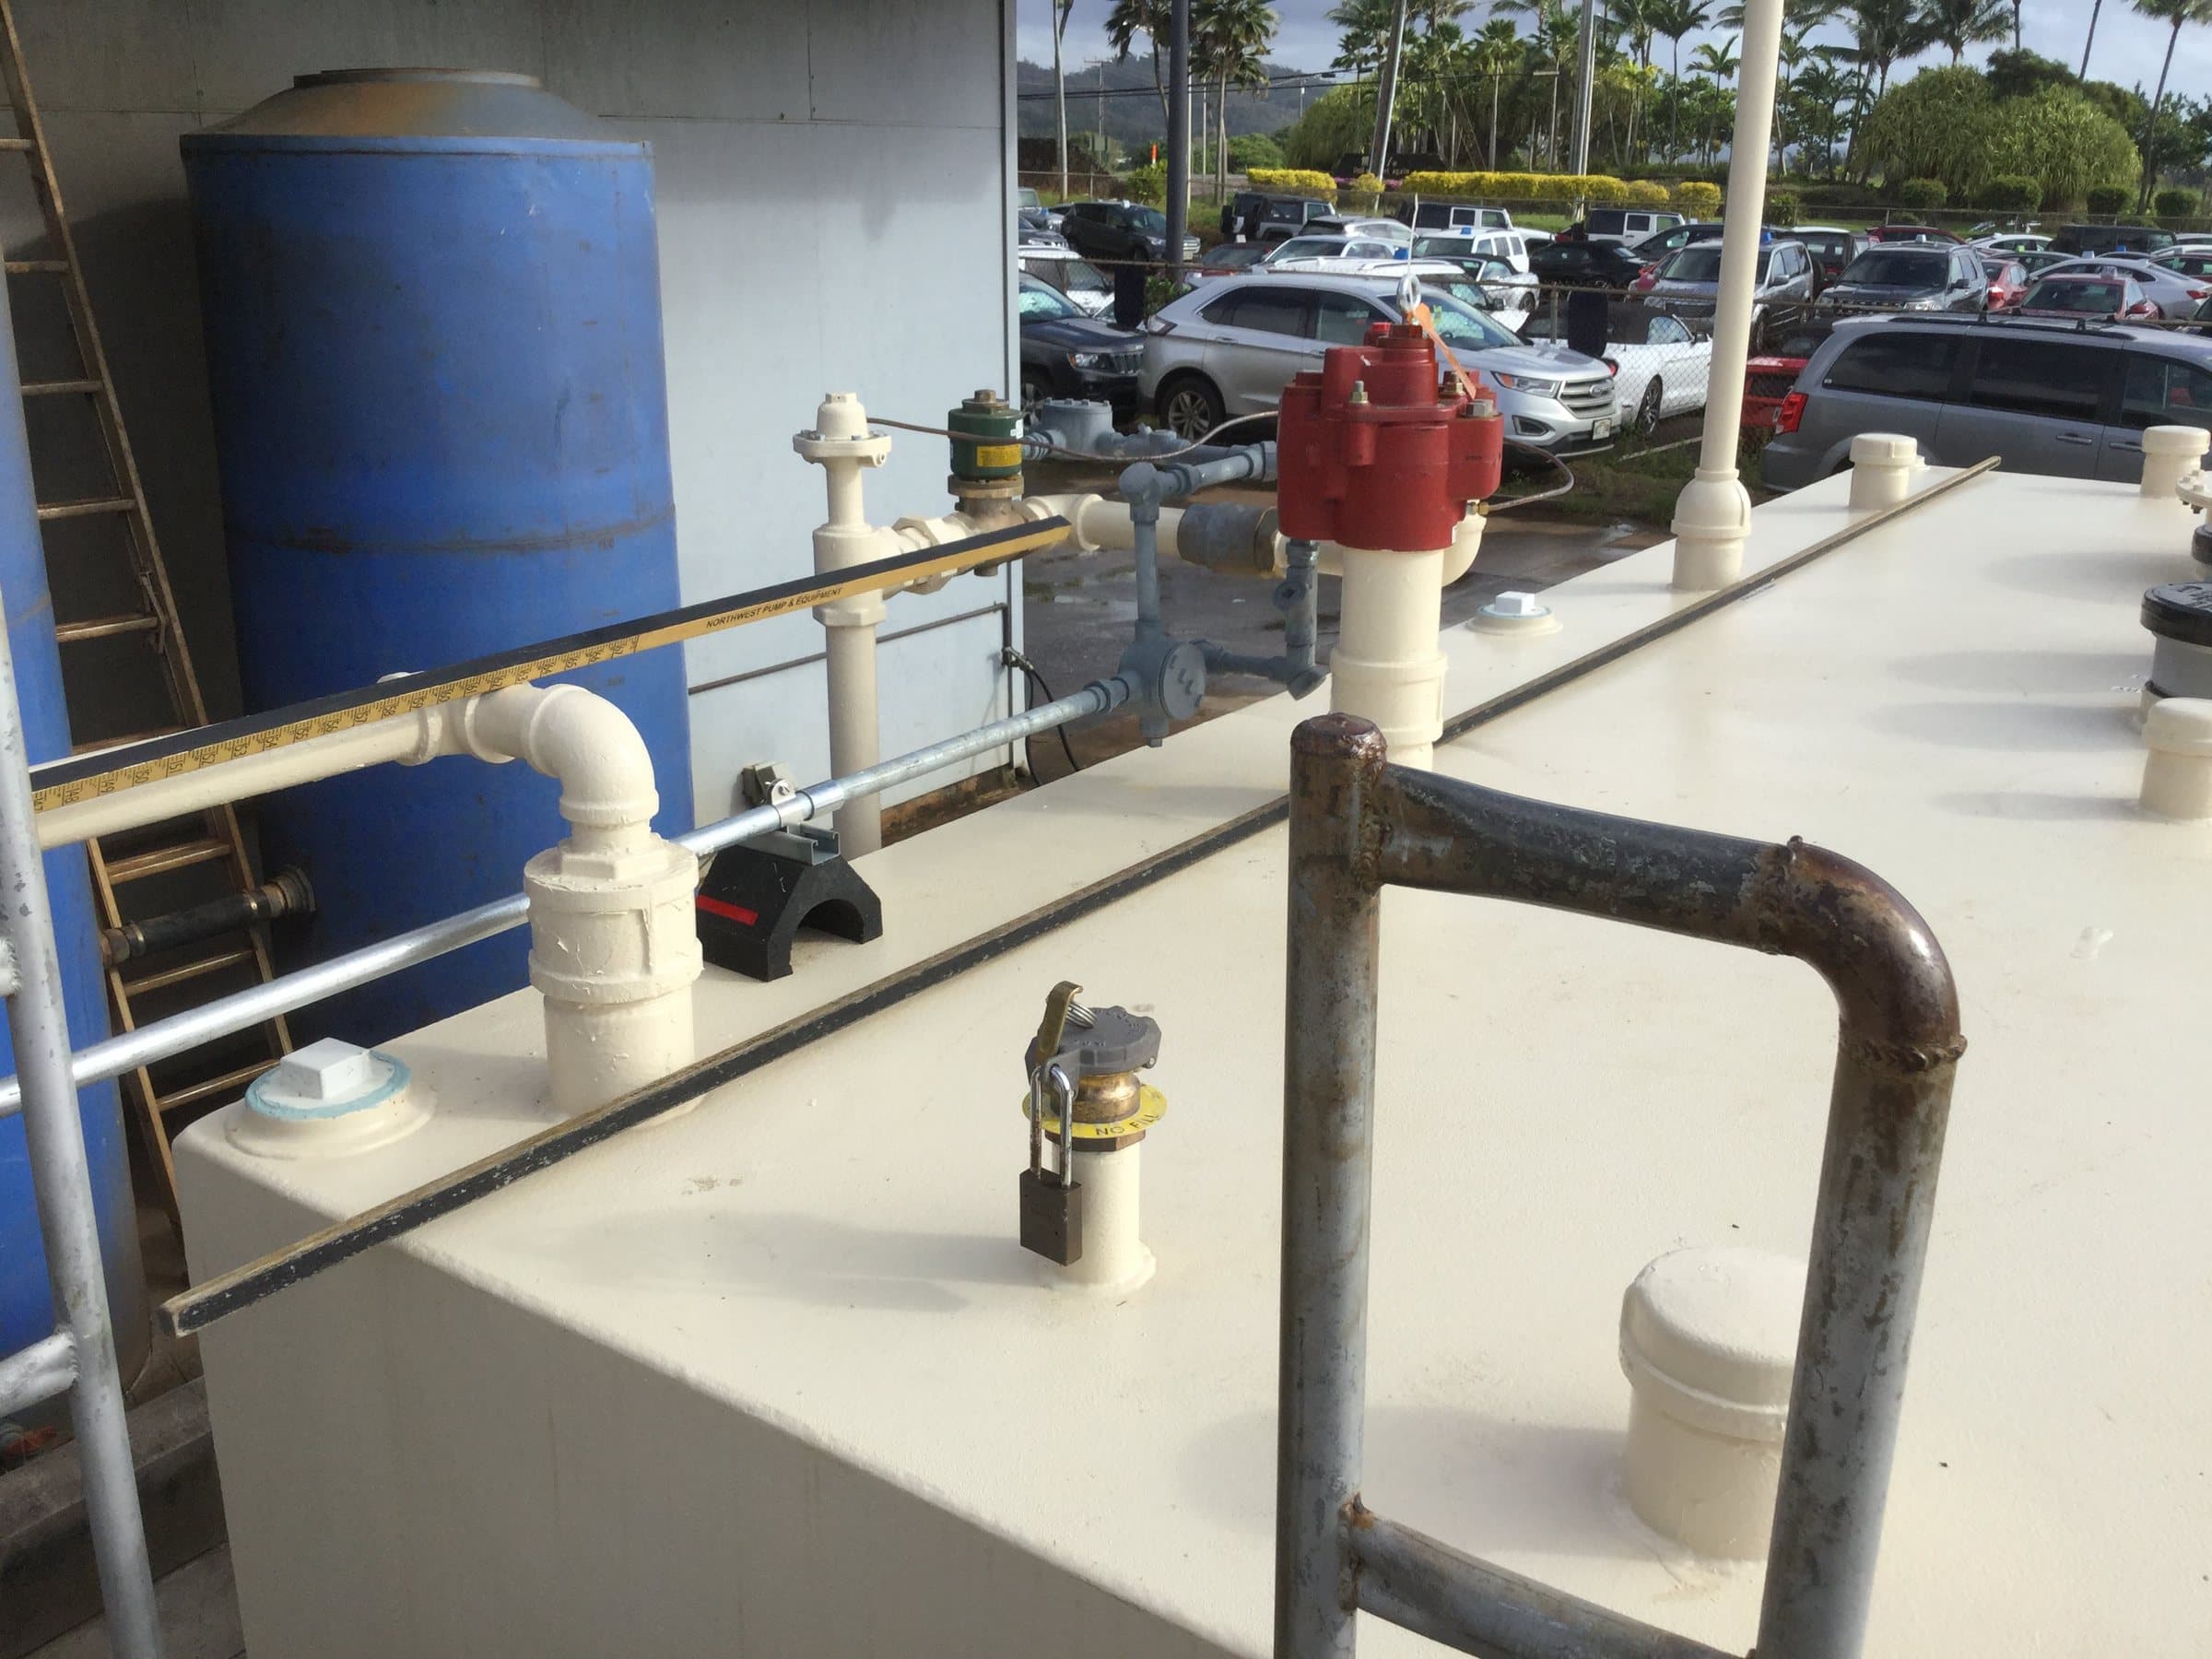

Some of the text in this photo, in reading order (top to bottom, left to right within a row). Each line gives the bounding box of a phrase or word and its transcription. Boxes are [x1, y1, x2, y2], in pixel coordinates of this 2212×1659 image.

[706, 587, 843, 629] NORTHWEST PUMP & EQUIPMENT
[233, 743, 248, 757] 153
[202, 751, 216, 764] 152
[169, 760, 182, 773] 151
[135, 769, 149, 783] 150
[100, 779, 115, 794] 149
[65, 786, 80, 803] 148
[1095, 1113, 1159, 1136] NO FILL
